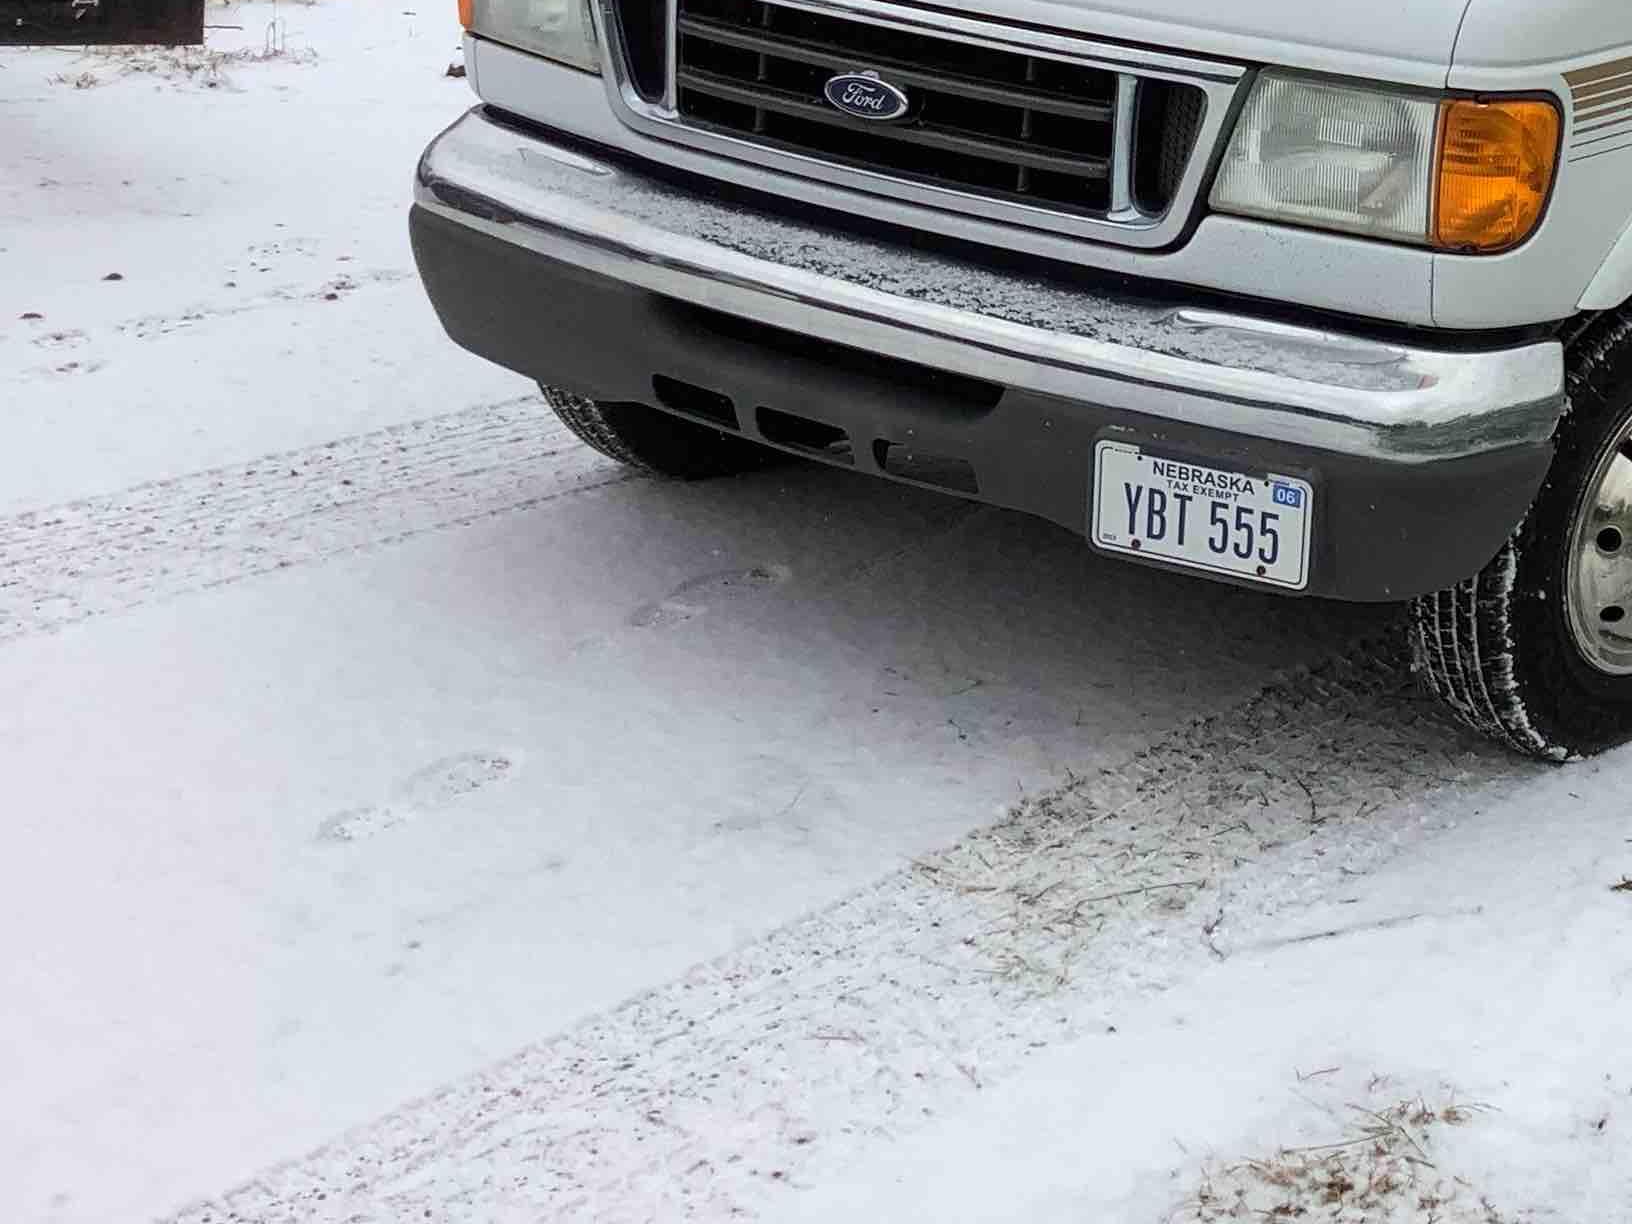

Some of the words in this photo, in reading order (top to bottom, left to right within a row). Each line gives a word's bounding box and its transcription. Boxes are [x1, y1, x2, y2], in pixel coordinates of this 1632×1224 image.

[842, 82, 885, 110] Ford
[1153, 460, 1255, 495] NEBRASKA
[1166, 479, 1190, 493] TAX
[1193, 485, 1240, 502] EXEMPT
[1276, 487, 1296, 505] 06
[1124, 482, 1193, 546] YBT
[1208, 500, 1280, 565] 555
